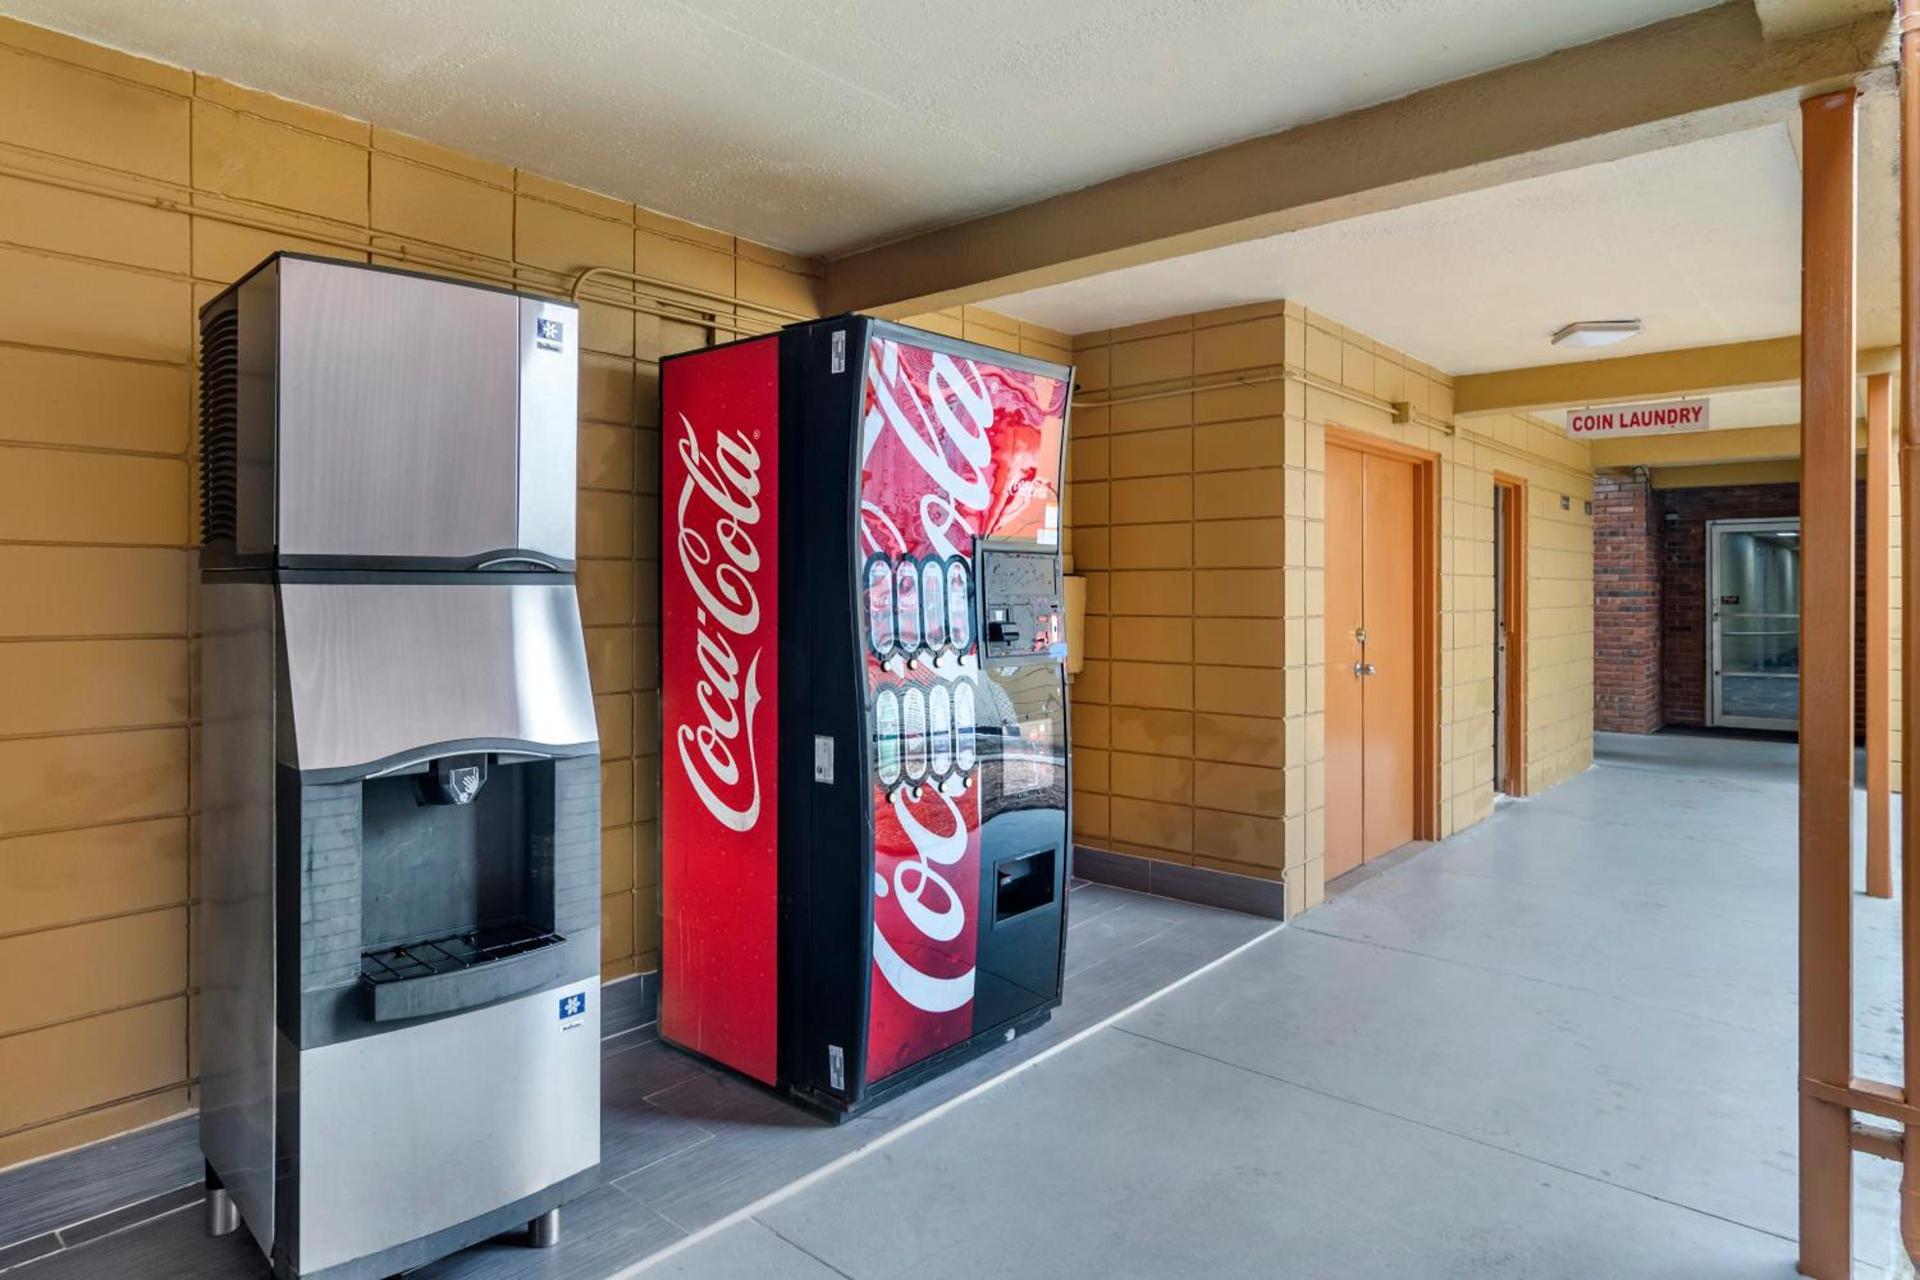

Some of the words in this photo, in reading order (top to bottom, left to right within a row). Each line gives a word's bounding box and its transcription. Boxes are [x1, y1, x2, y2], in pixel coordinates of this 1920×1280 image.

[1572, 413, 1614, 432] COIN
[1619, 406, 1703, 429] LAUNDRY
[677, 412, 762, 832] Coca-Cola
